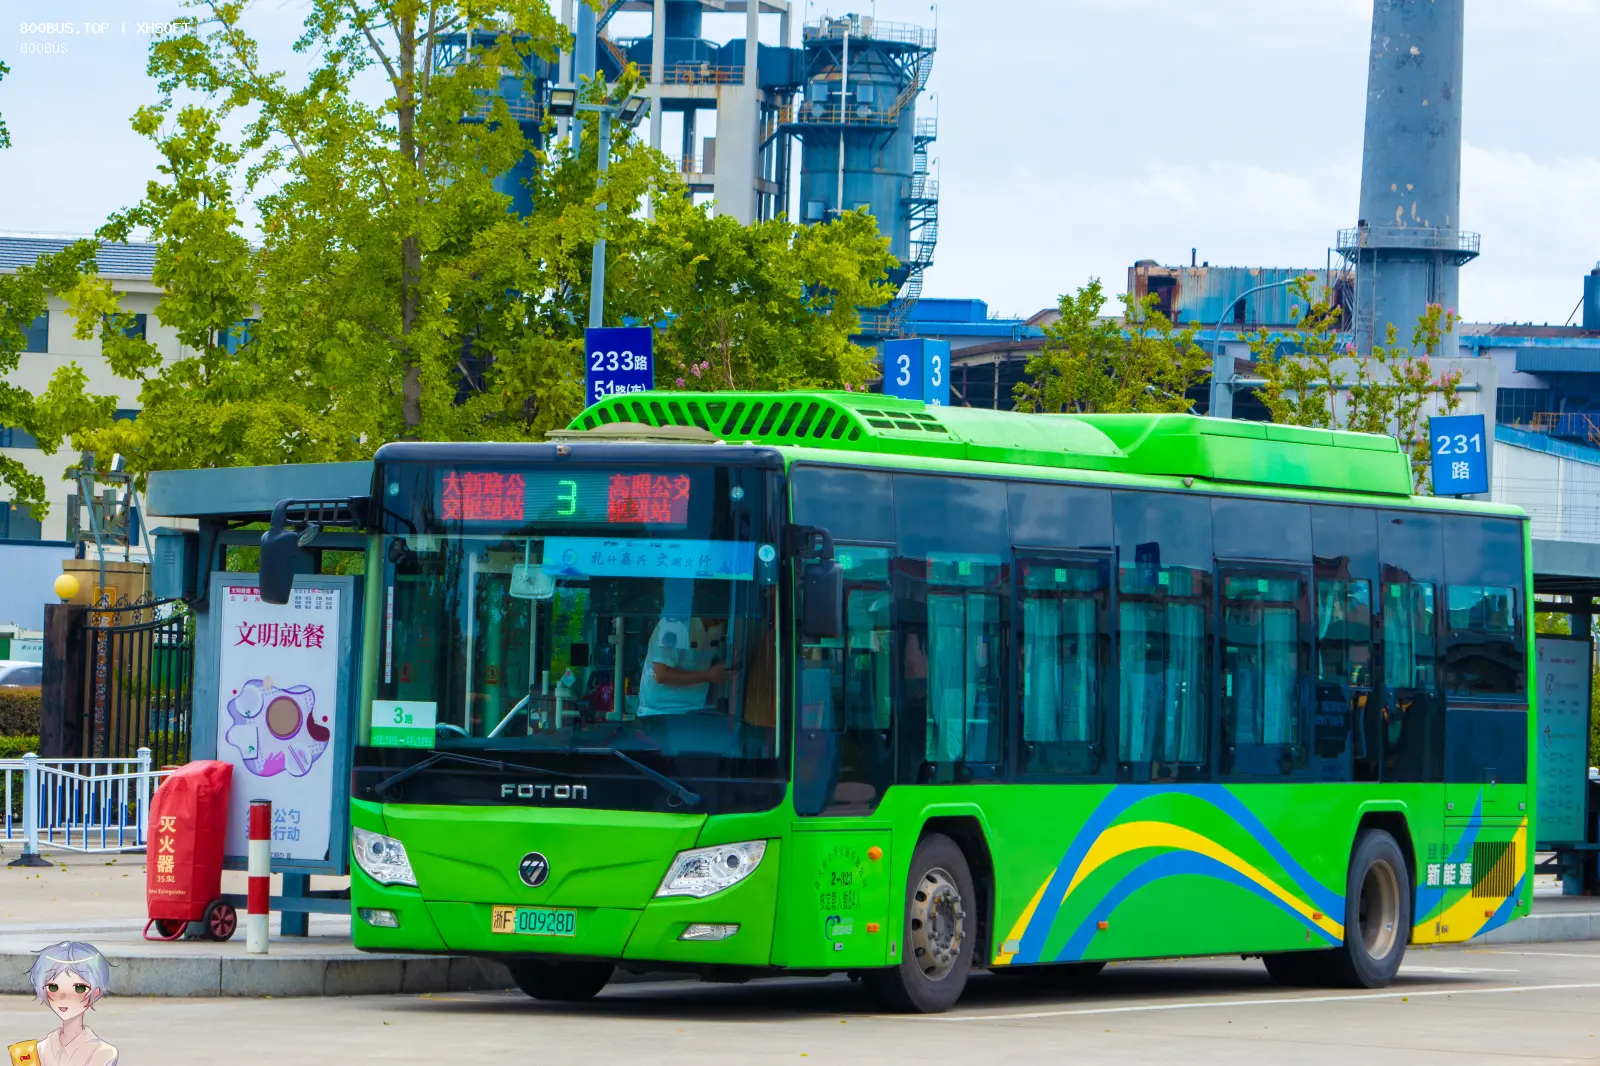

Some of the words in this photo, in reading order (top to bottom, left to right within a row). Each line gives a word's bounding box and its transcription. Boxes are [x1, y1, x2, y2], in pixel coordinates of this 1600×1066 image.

[591, 350, 648, 371] 233路
[896, 354, 911, 386] 3
[931, 354, 942, 387] 3
[1436, 433, 1481, 455] 231
[1451, 461, 1470, 479] 路
[557, 480, 577, 515] 3
[233, 621, 325, 649] 文明就餐
[393, 706, 413, 724] 3路
[500, 783, 588, 800] FOTON
[157, 816, 177, 874] 灭火器
[1426, 862, 1473, 886] 新能源
